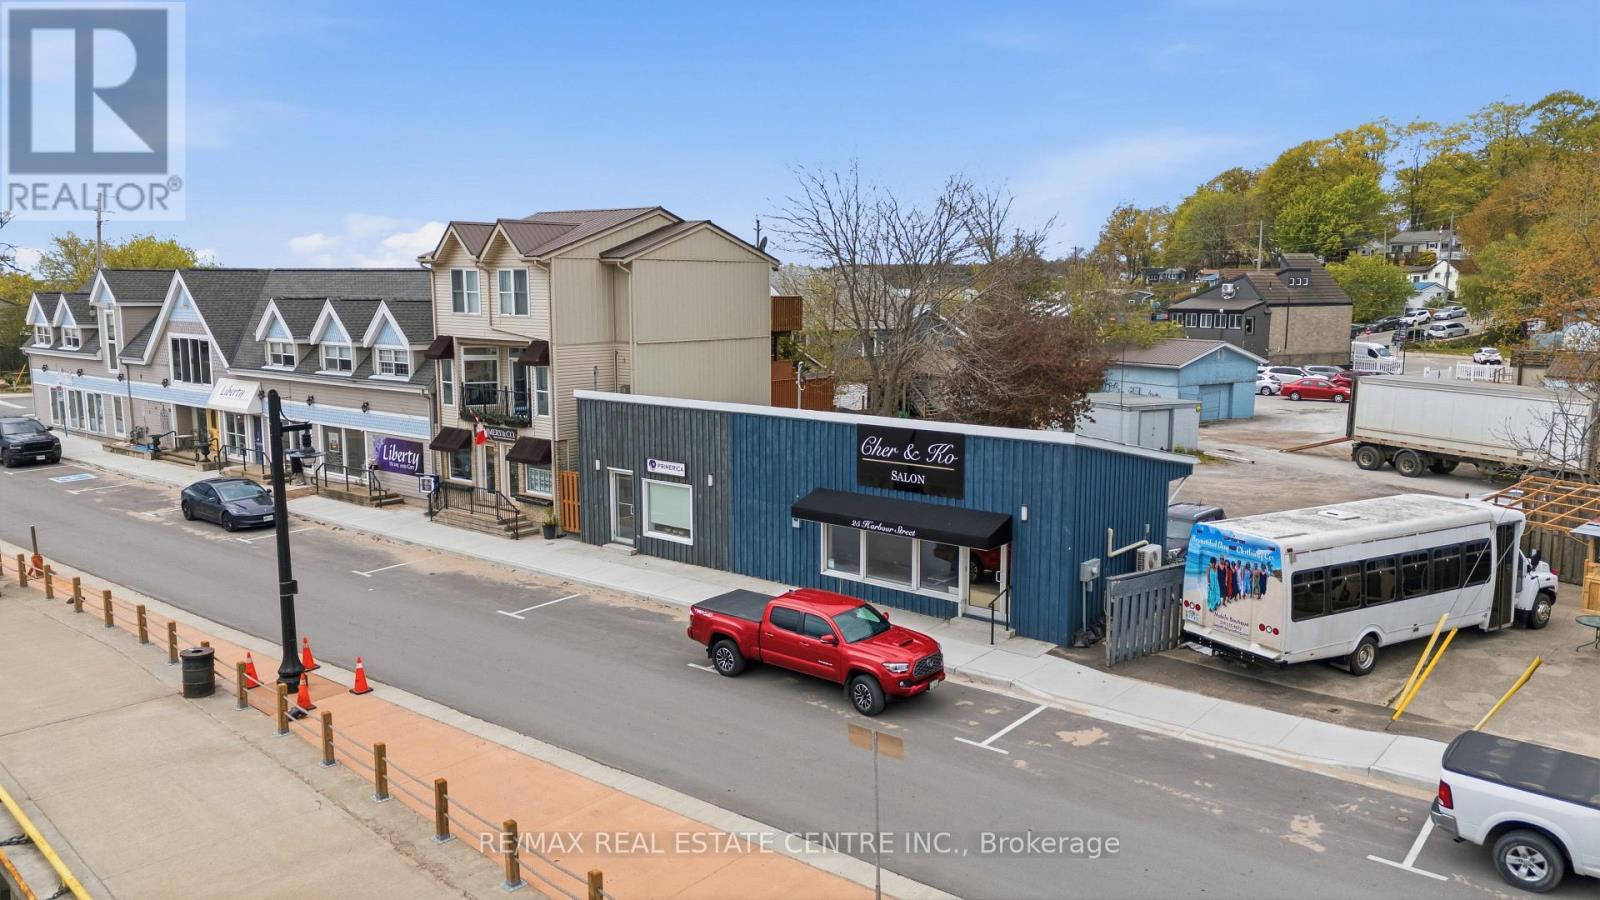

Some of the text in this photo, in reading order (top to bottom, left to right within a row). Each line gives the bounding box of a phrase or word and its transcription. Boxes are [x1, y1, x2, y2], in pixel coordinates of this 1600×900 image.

[383, 444, 420, 471] Liberty
[861, 435, 959, 465] Cher & Ko
[657, 463, 683, 472] PRIMERICA
[891, 470, 926, 485] SALON
[861, 520, 894, 533] Harbour
[895, 525, 916, 537] Street
